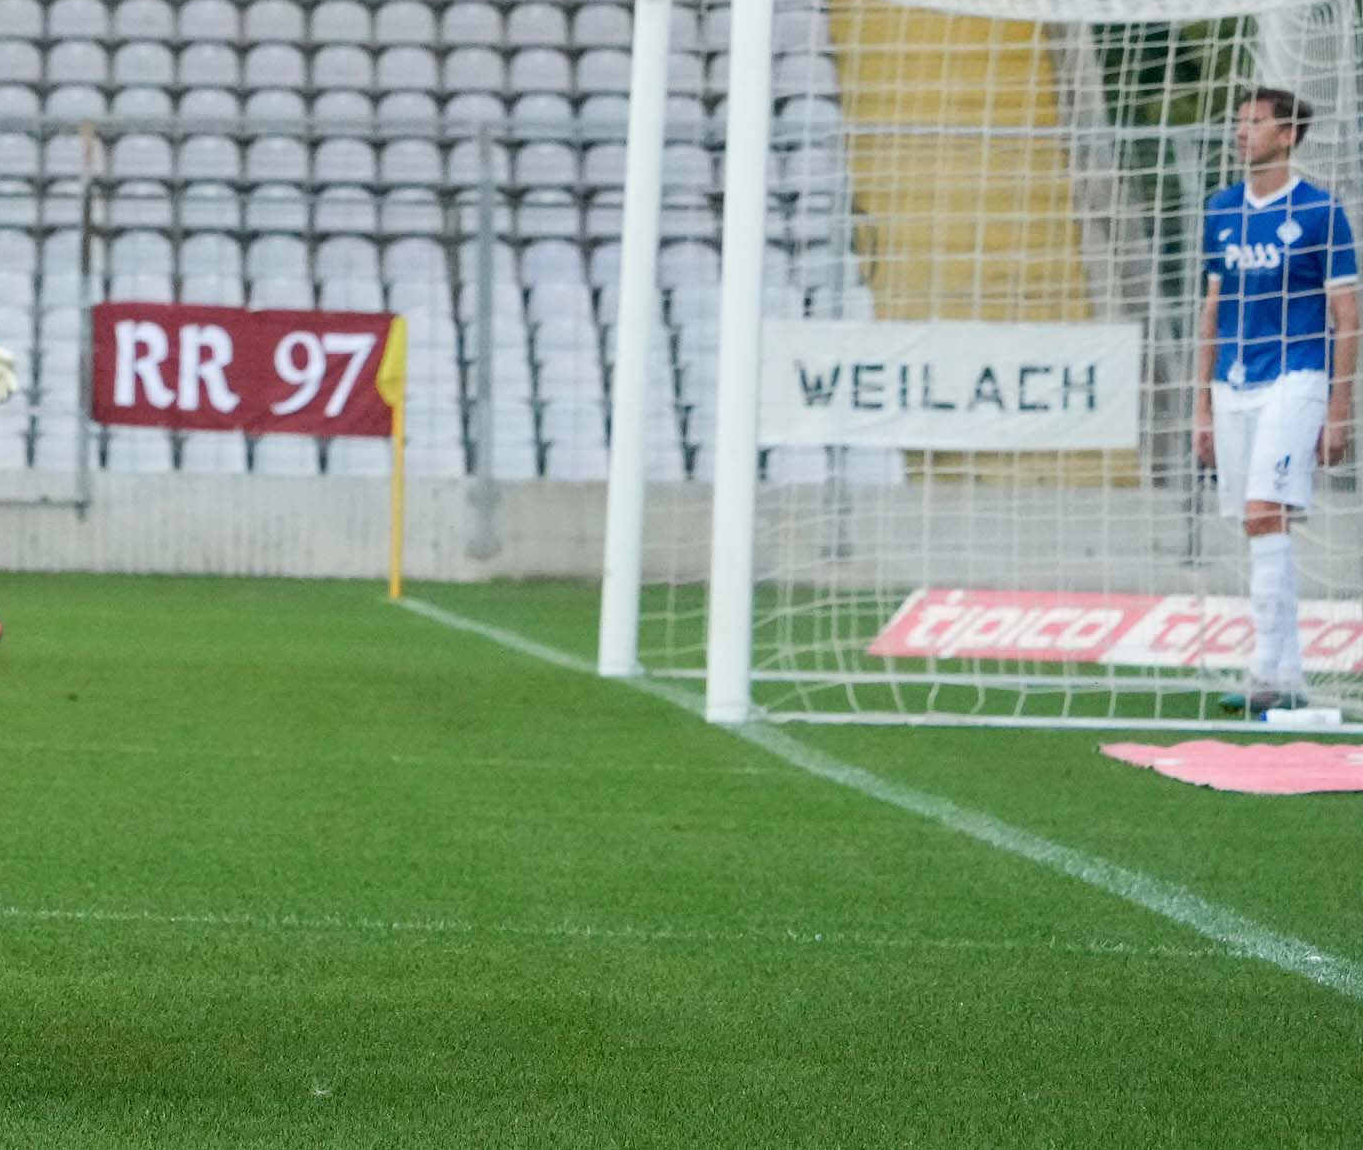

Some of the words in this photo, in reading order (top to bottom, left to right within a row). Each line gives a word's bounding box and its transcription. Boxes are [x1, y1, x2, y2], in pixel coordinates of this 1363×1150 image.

[113, 320, 241, 413] RR
[270, 330, 377, 418] 97
[794, 359, 1095, 411] WEILACH
